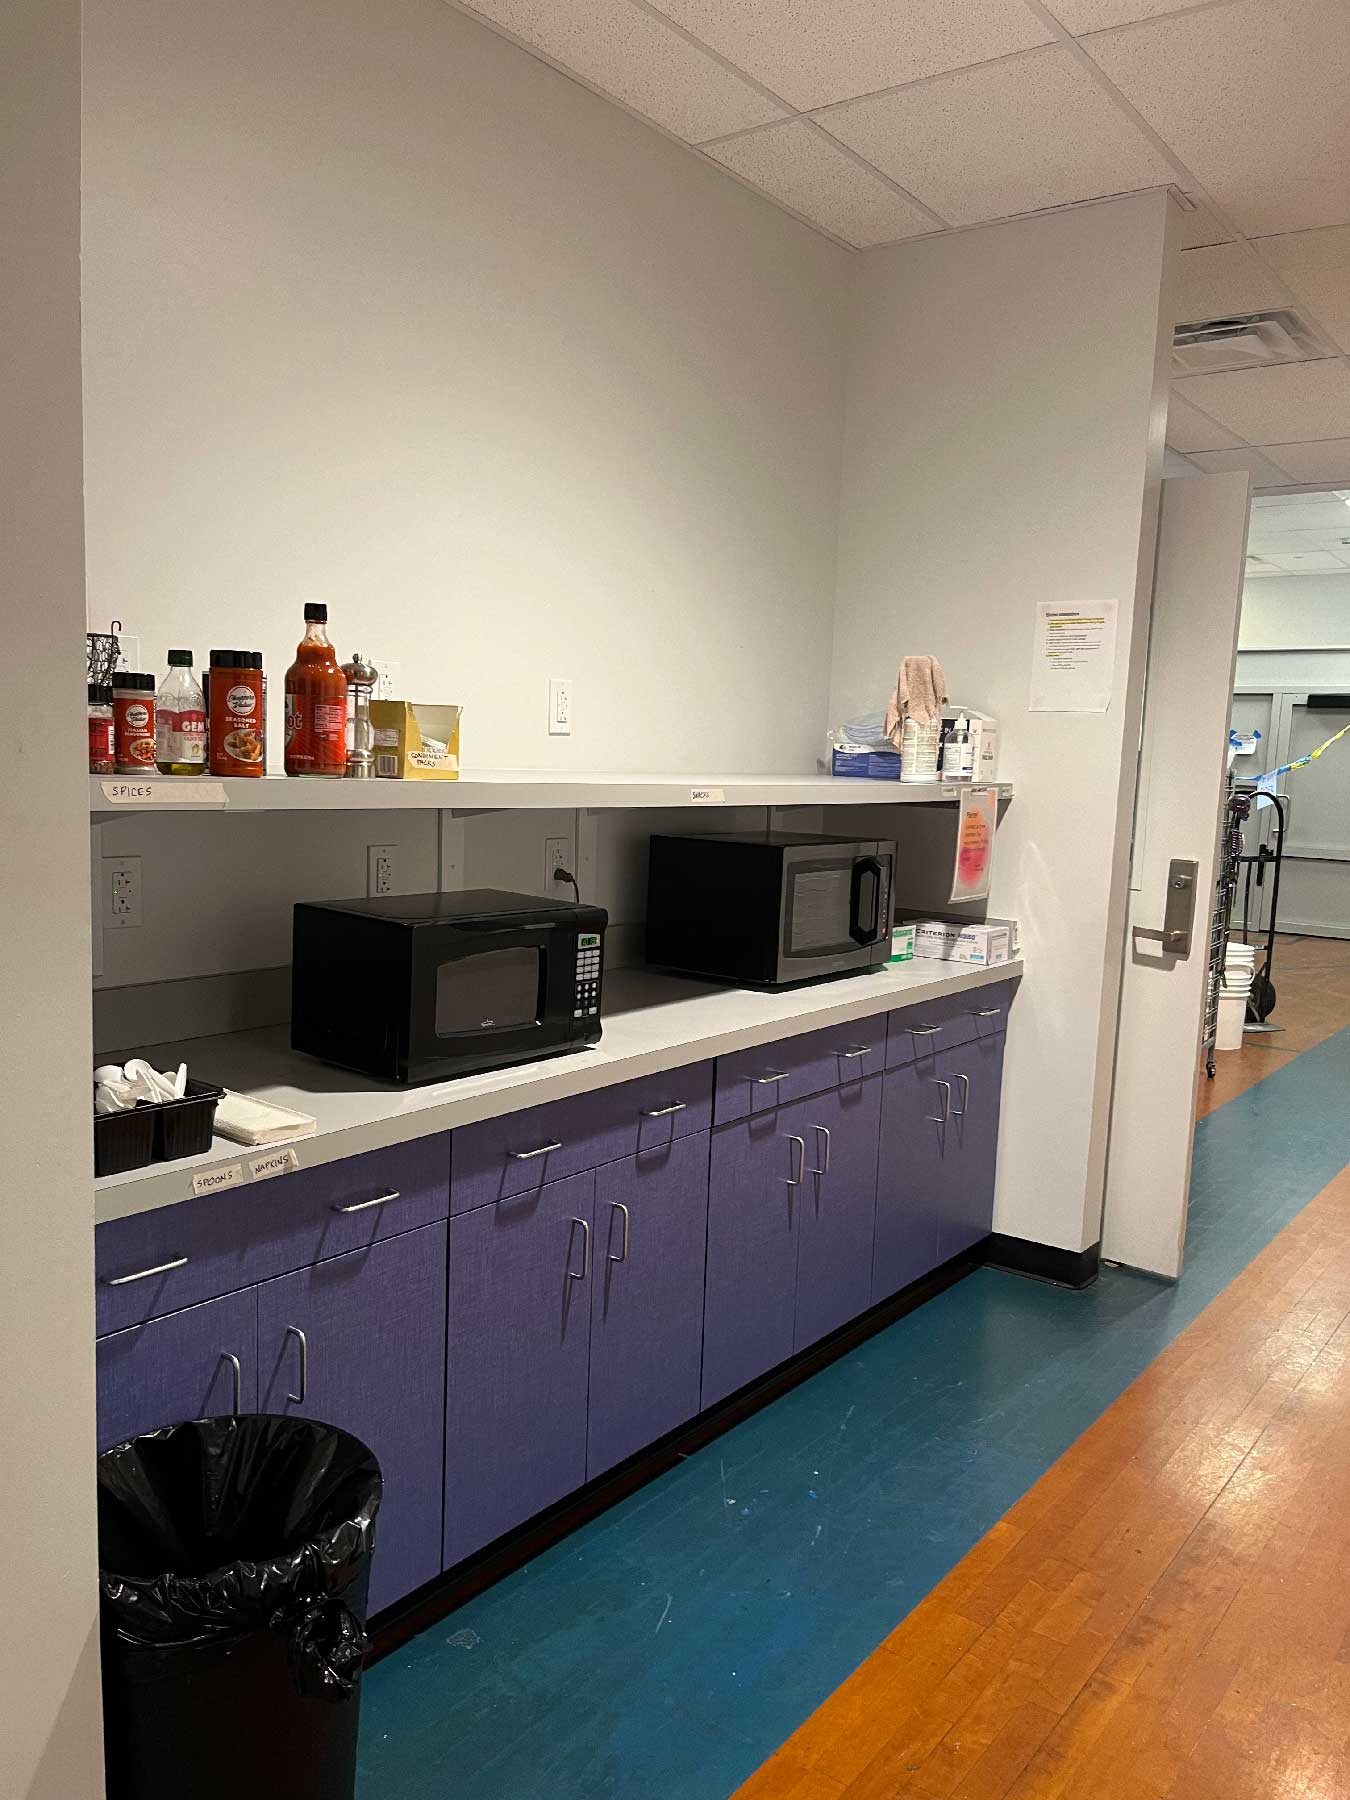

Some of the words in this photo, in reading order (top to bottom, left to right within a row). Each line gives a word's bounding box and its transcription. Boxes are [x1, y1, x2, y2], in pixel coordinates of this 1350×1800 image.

[112, 785, 152, 797] SPICES
[916, 928, 955, 938] CRITERION
[255, 1154, 289, 1174] NAPKINS
[197, 1171, 233, 1188] SPOONS
